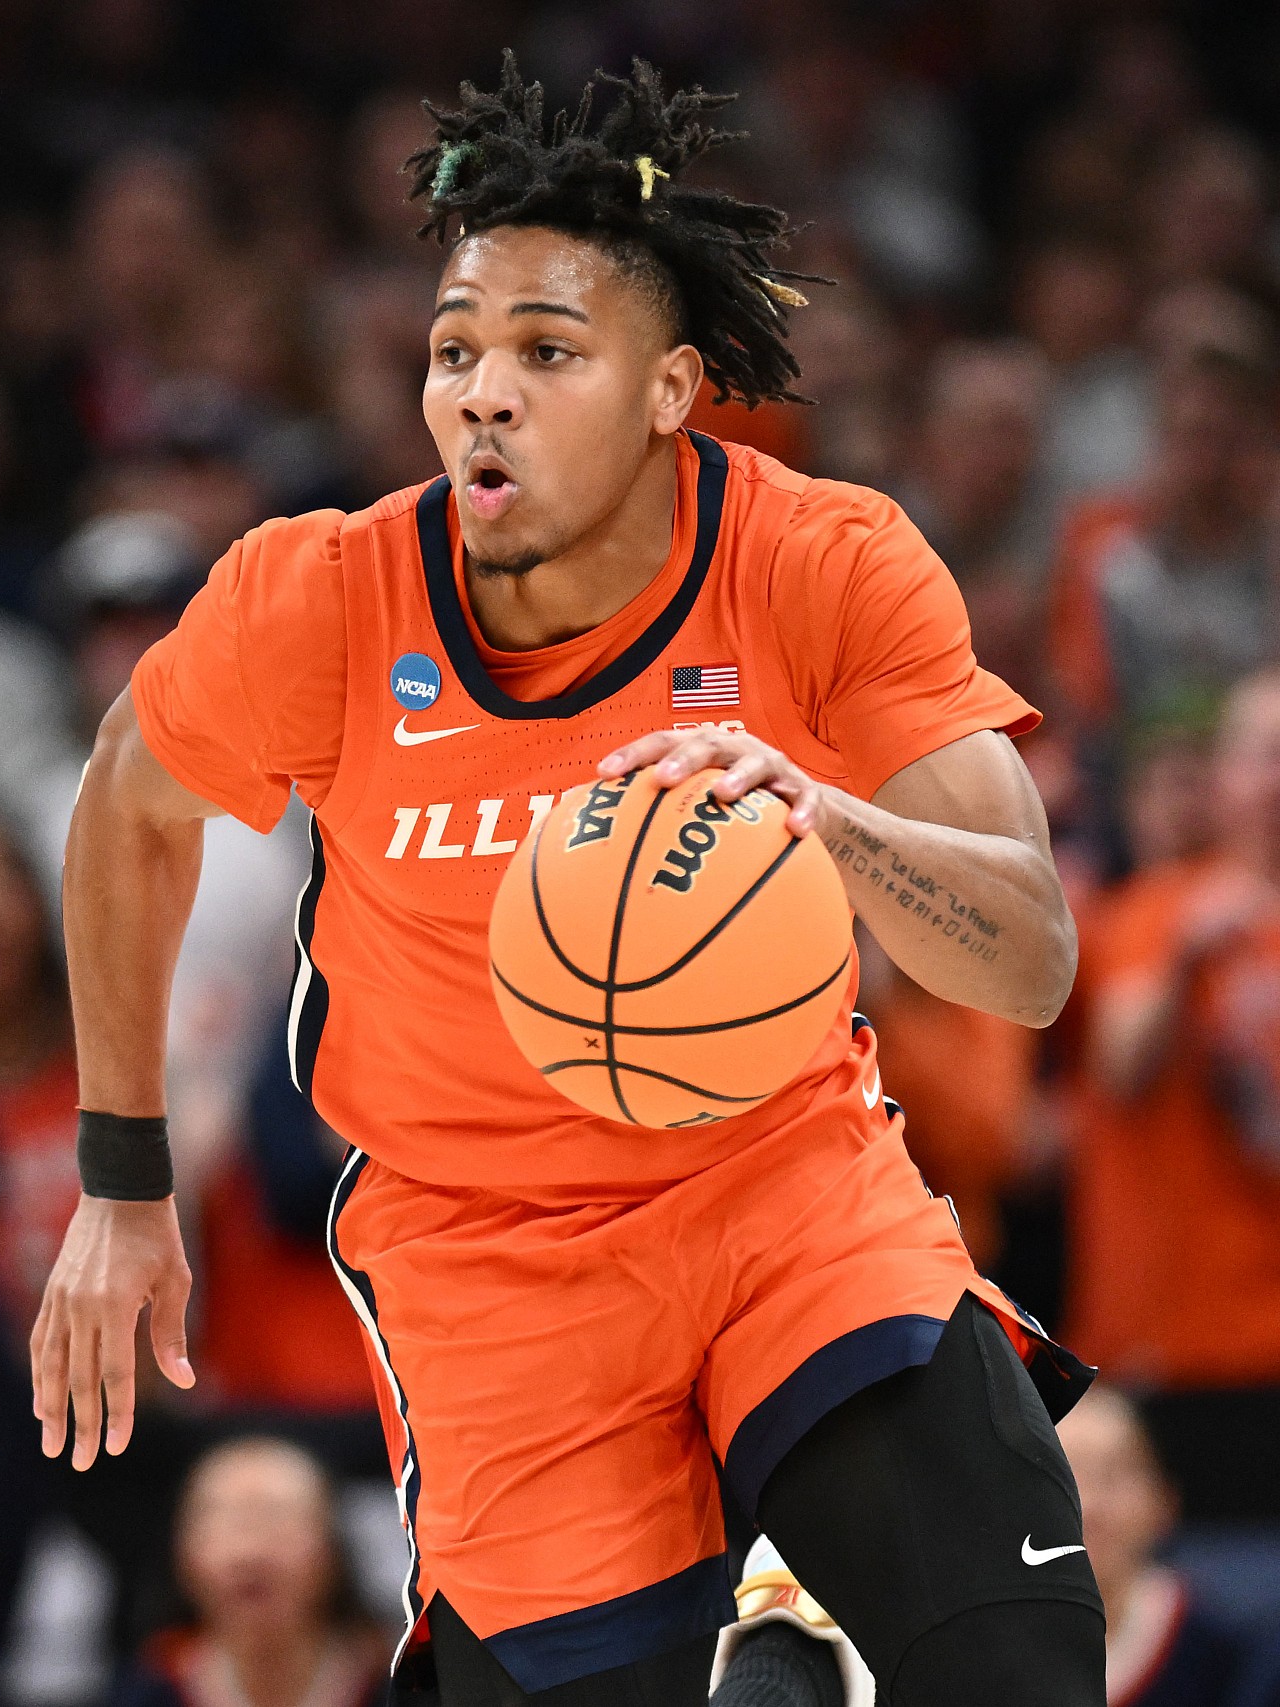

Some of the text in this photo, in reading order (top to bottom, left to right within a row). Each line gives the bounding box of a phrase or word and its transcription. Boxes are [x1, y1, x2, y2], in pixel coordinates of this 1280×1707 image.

[395, 677, 437, 700] NCAA
[568, 771, 637, 849] AA
[652, 786, 775, 893] lson
